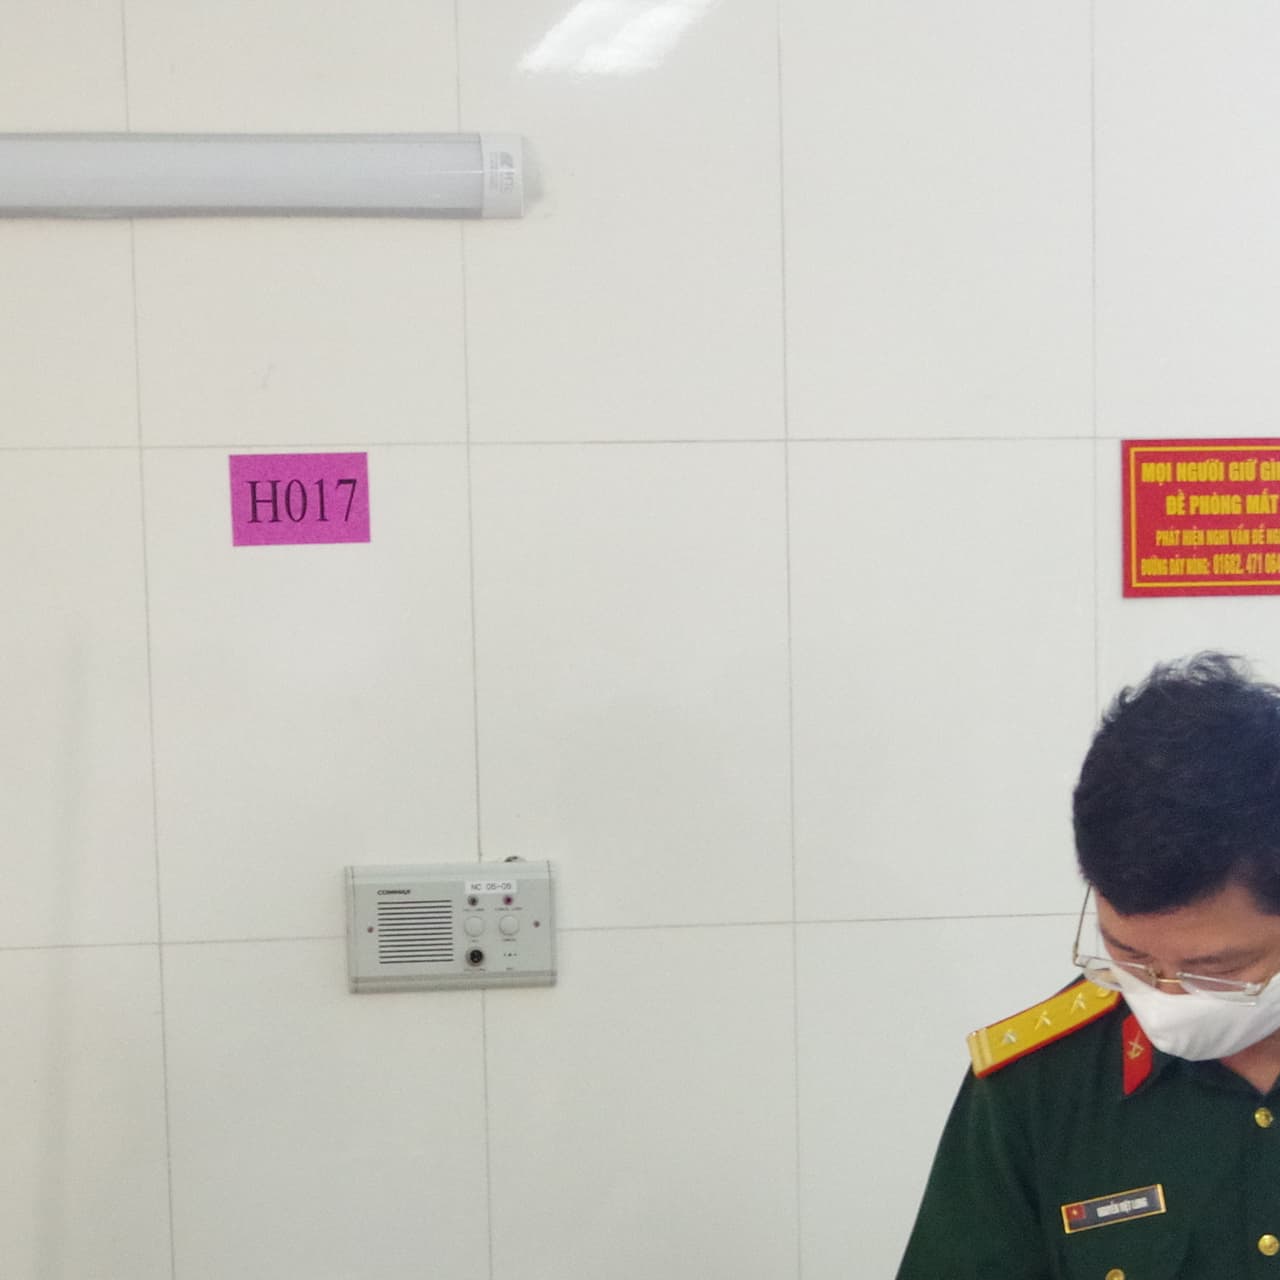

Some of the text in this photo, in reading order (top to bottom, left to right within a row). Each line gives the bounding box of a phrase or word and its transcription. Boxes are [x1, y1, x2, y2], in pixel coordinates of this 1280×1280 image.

[1141, 462, 1172, 486] MỌI
[1176, 458, 1224, 482] NGƯỜI
[1228, 458, 1257, 482] GIỮ
[246, 478, 358, 523] H017
[1166, 488, 1187, 516] ĐỀ
[1189, 491, 1242, 516] PHÒNG
[1246, 488, 1279, 515] MẤT
